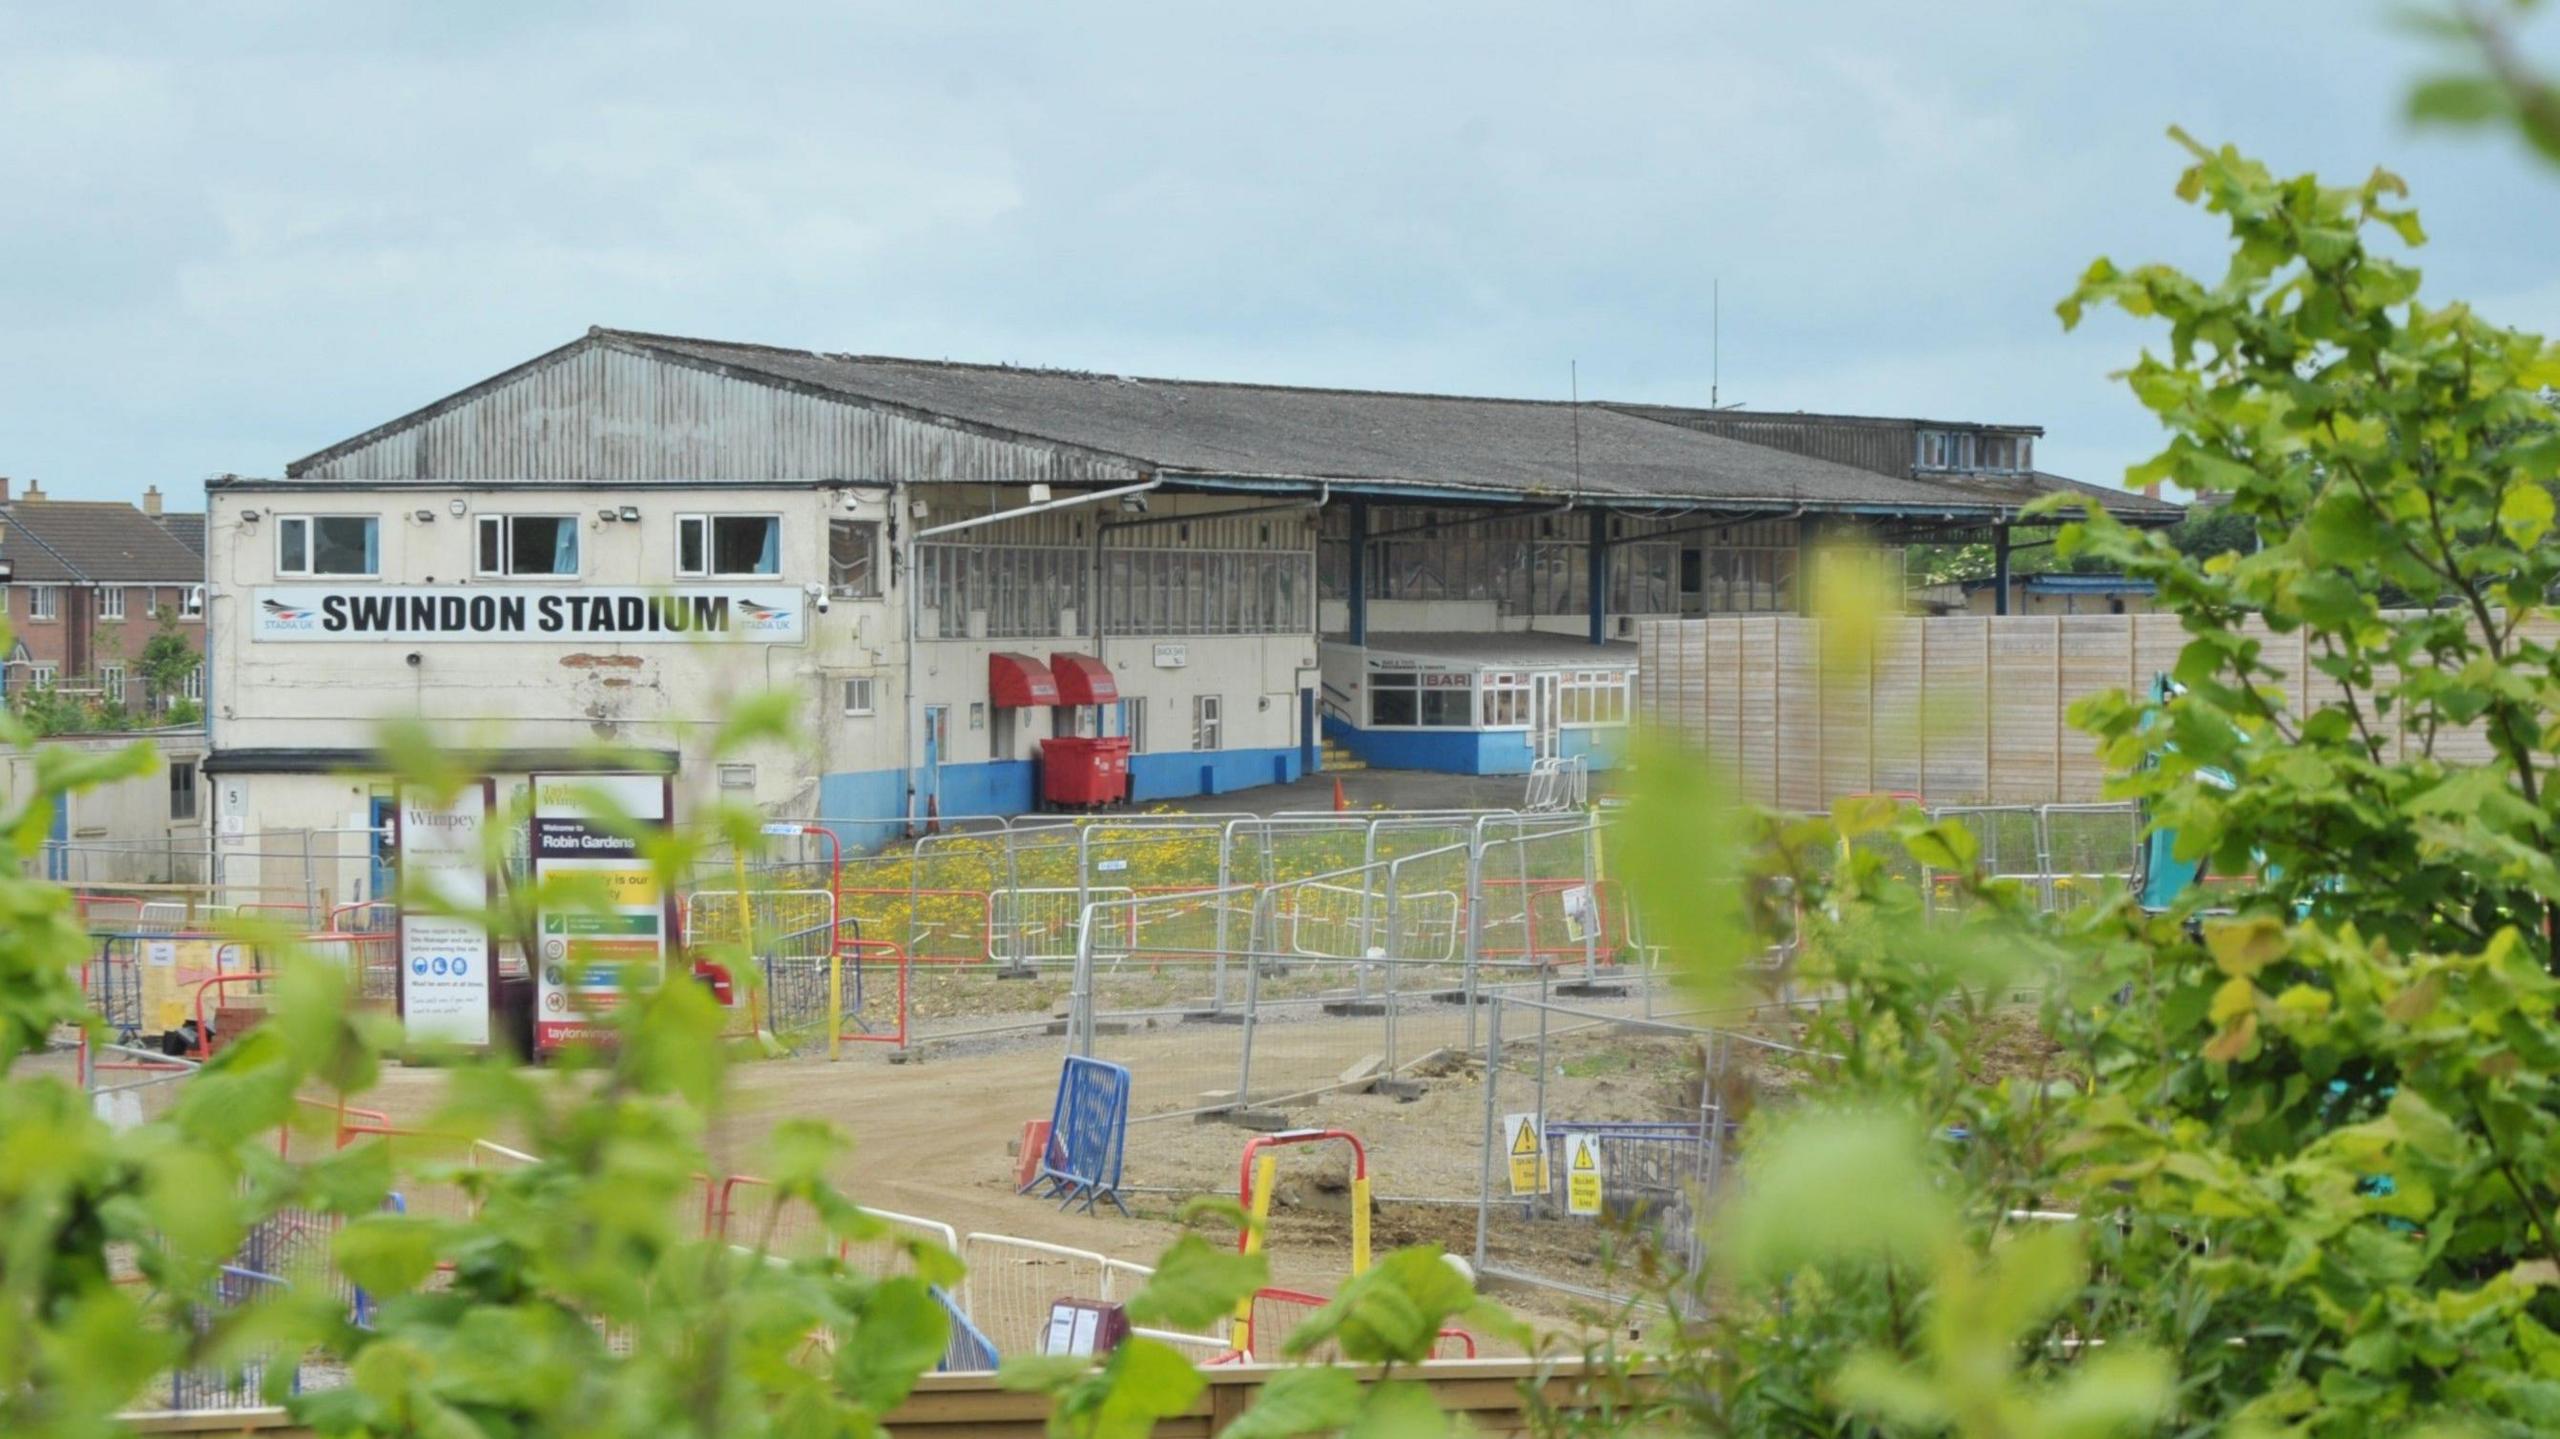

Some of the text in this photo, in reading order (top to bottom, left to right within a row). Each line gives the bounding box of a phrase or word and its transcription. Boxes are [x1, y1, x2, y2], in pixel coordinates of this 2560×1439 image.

[322, 595, 729, 632] SWINDON STADIUM
[264, 620, 314, 629] STADIA UK
[741, 620, 790, 630] STADIA UK
[1426, 673, 1466, 687] BAR
[229, 790, 238, 804] 5
[409, 811, 477, 831] Wimpey
[542, 824, 575, 832] Welcome
[543, 835, 636, 849] Robin Gardens
[615, 875, 625, 885] is
[628, 876, 648, 885] our
[547, 1027, 618, 1042] taylorwimpe
